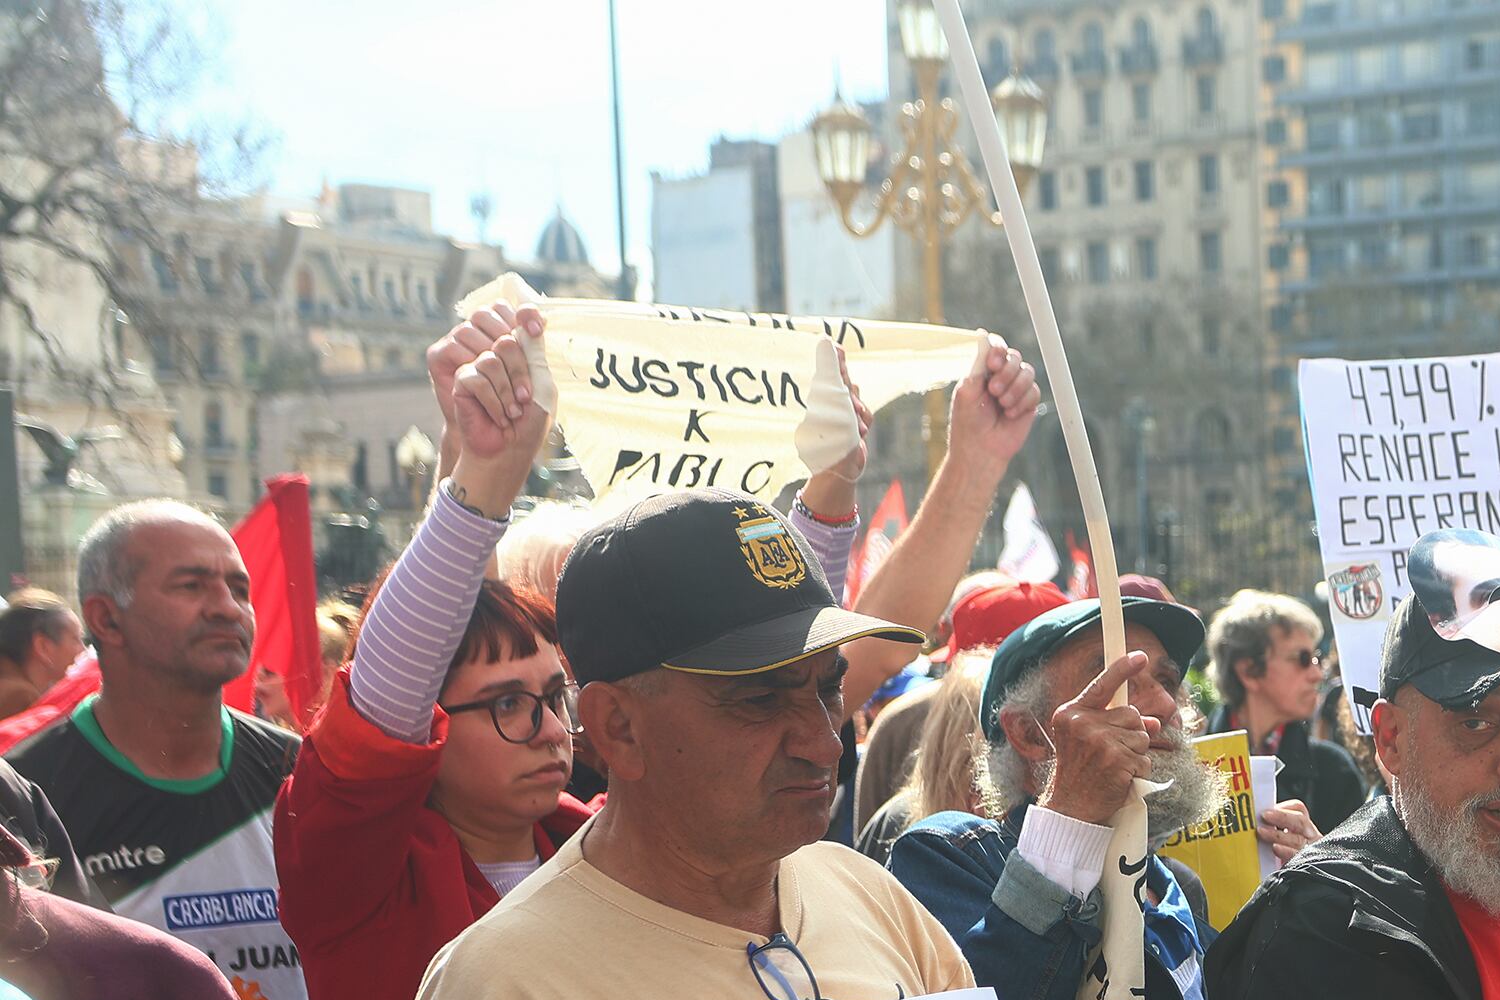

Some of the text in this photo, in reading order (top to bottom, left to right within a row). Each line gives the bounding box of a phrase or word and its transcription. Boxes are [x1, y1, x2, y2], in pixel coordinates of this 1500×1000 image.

[1338, 431, 1476, 482] RENACE
[85, 843, 166, 878] mitre
[168, 891, 277, 927] CASABLANCA
